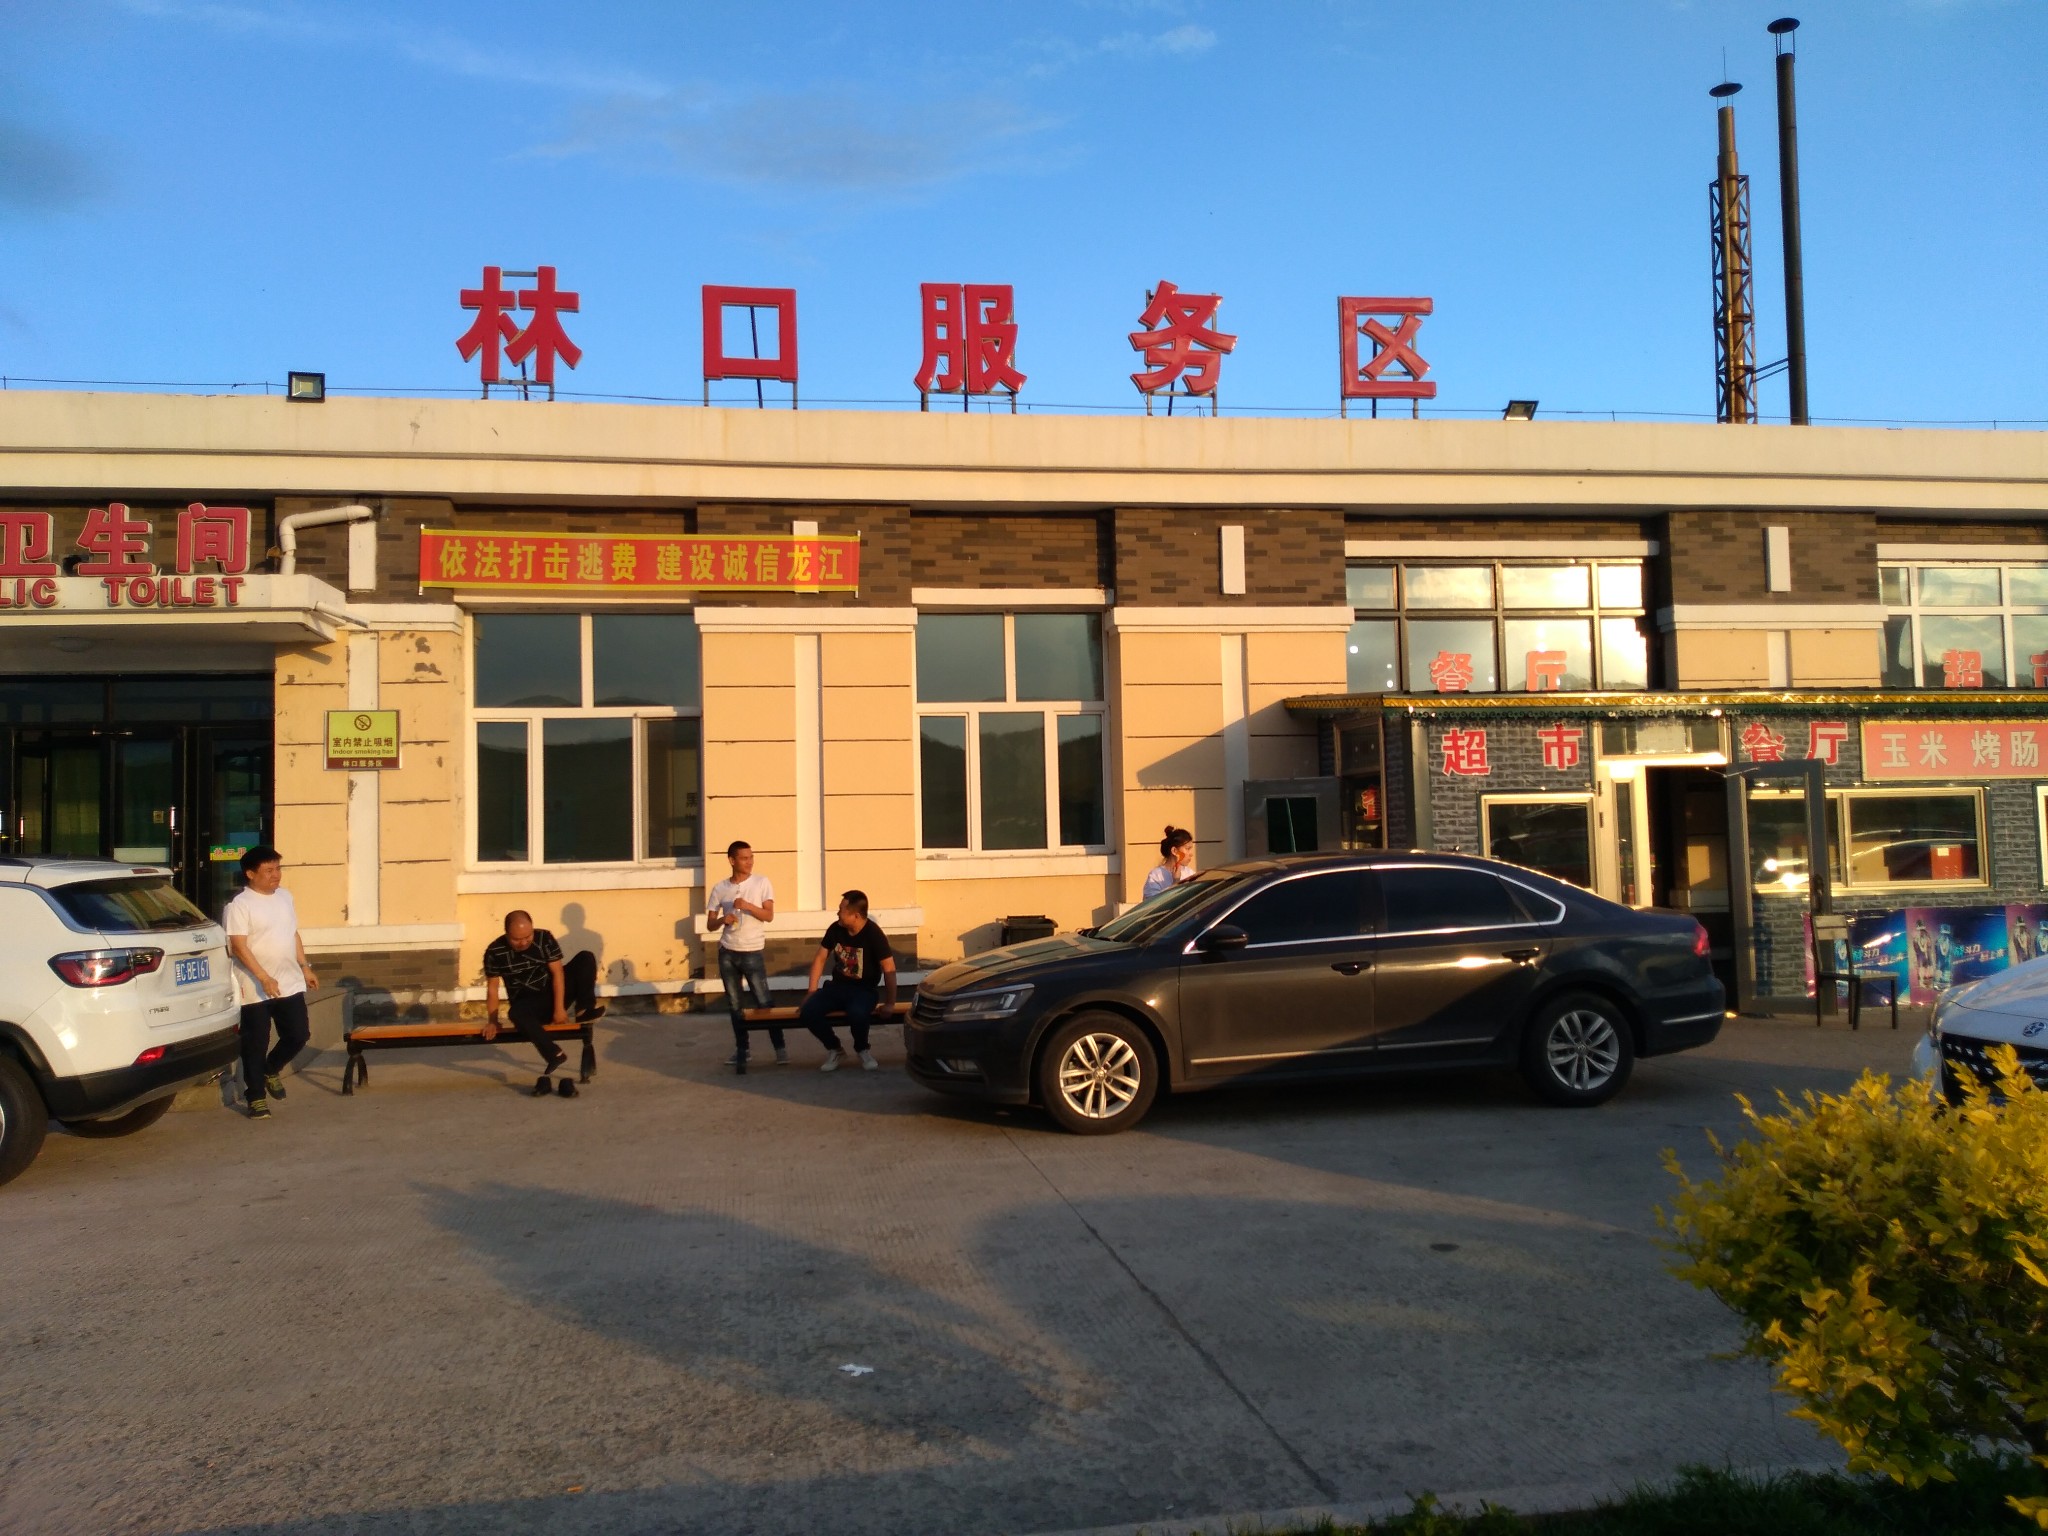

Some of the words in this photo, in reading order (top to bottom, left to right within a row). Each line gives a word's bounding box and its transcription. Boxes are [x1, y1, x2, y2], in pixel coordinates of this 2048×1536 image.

[455, 265, 1437, 399] 林口服务区
[0, 503, 251, 576] 卫生间
[440, 538, 638, 581] 依法打击逃费
[656, 542, 844, 583] 建设诚信龙江
[103, 576, 245, 606] TOILET
[1429, 650, 1567, 693] 餐厅
[332, 737, 394, 748] 室内禁止吸烟
[354, 748, 381, 756] smoking
[1441, 722, 1584, 777] 超市
[1740, 721, 1849, 766] 餐厅
[1880, 730, 1948, 769] 玉米
[1971, 730, 2039, 769] 烤肠
